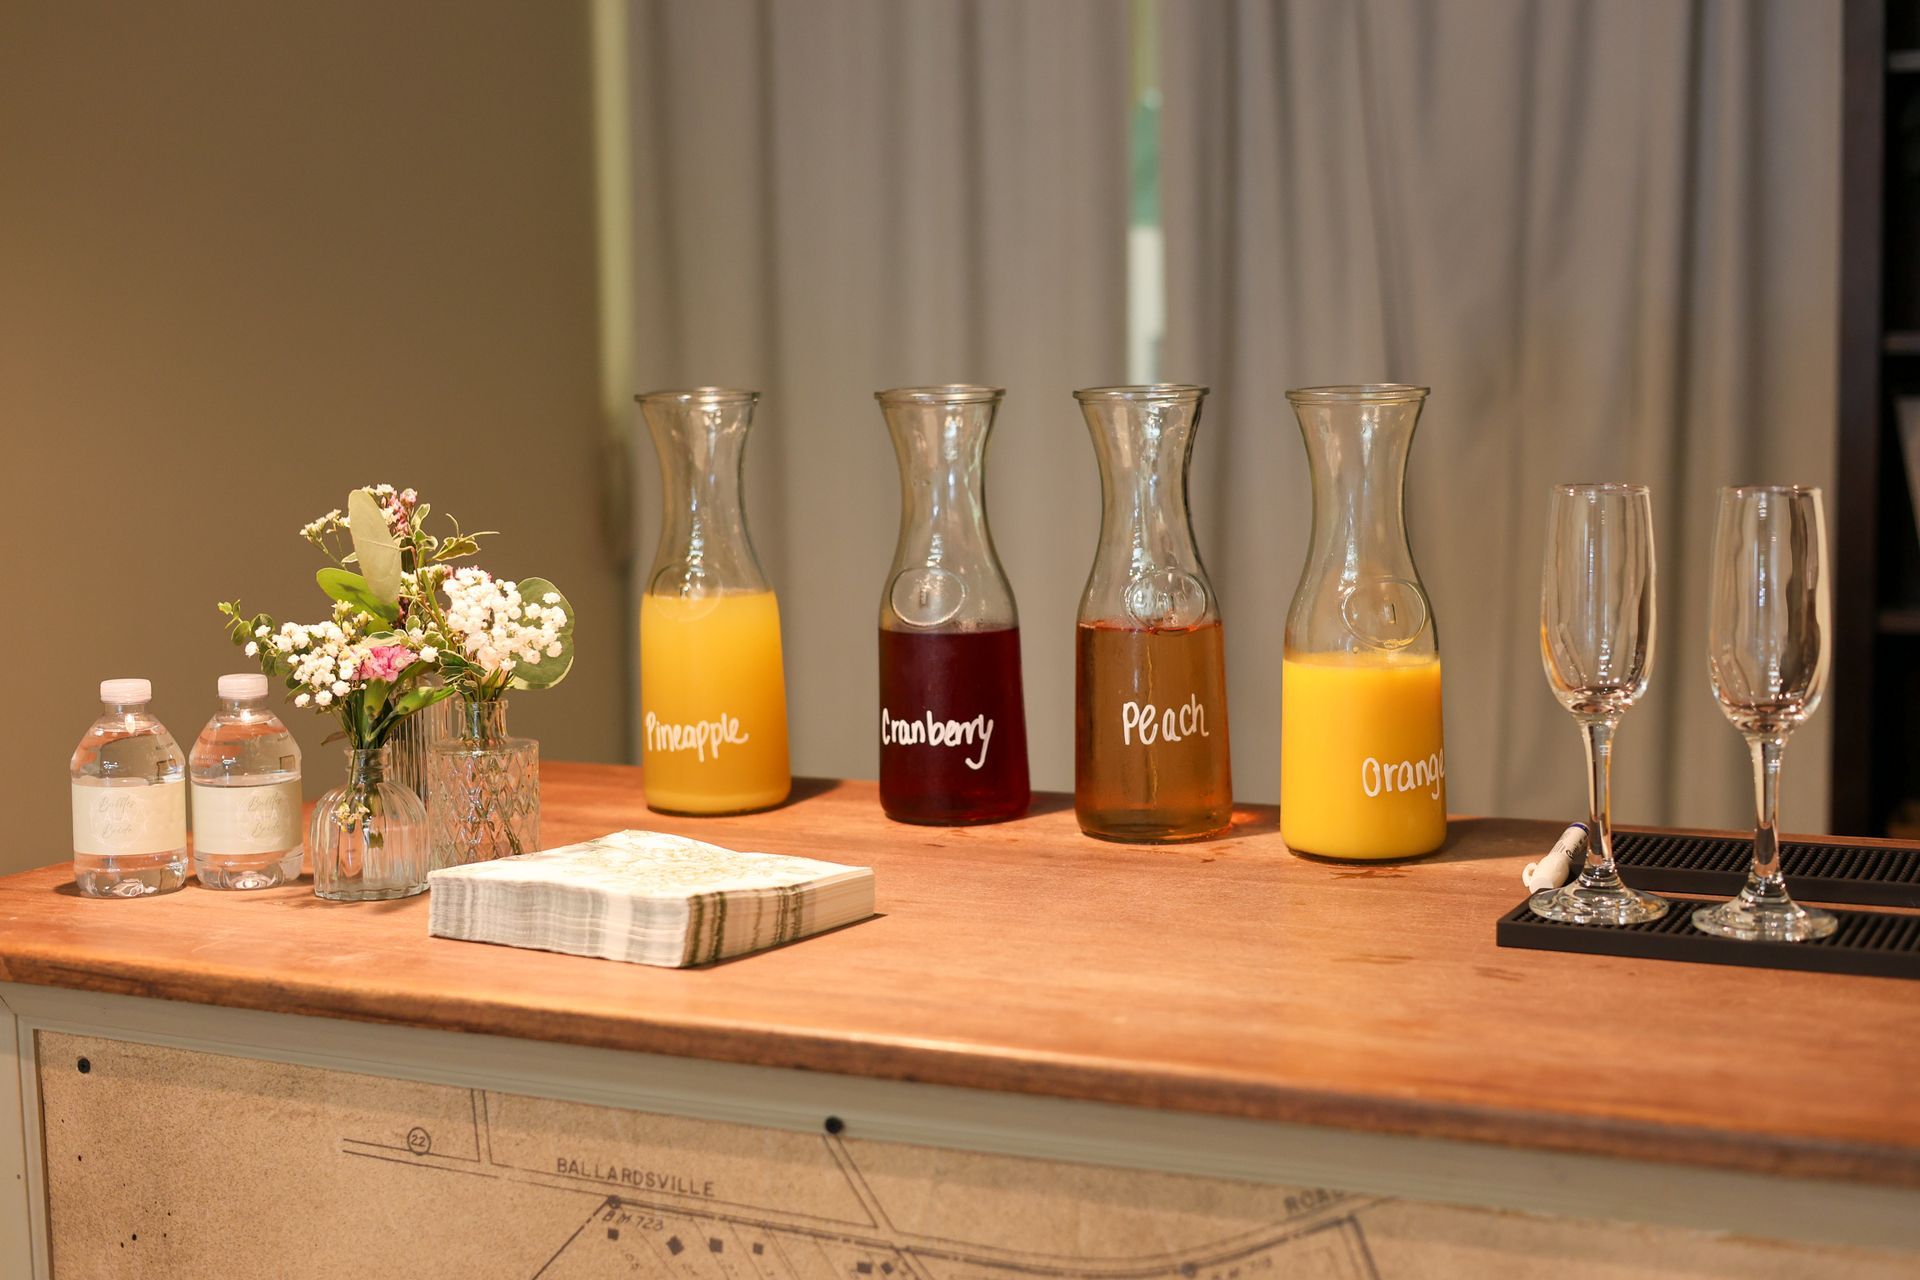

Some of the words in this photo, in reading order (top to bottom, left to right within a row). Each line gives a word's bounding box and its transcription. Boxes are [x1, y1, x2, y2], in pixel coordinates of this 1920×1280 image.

[645, 711, 749, 763] Pineapple
[881, 707, 994, 770] Cranberry
[1122, 692, 1209, 745] Peach
[1361, 748, 1445, 800] Orange
[410, 1134, 426, 1148] 22
[556, 1157, 715, 1197] BALLARDSVILLE
